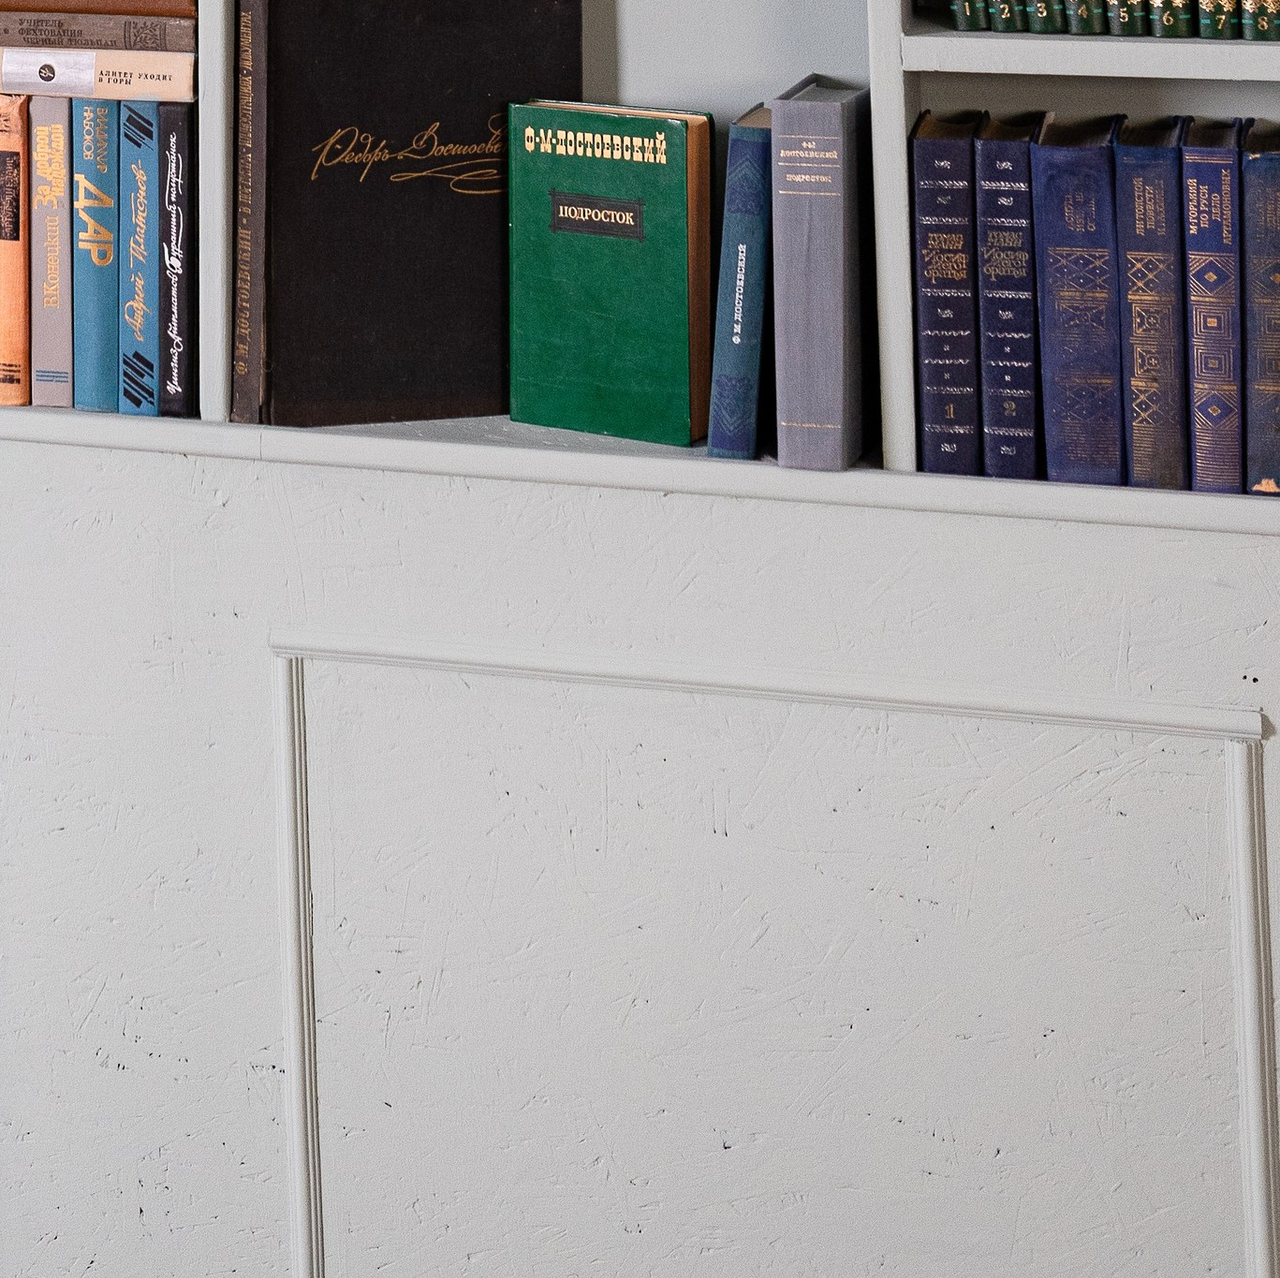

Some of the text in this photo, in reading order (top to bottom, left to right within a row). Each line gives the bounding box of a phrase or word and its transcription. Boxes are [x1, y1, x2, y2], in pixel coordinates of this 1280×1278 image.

[1000, 4, 1011, 19] 2
[1037, 3, 1047, 17] 3
[1119, 7, 1129, 23] 5
[1163, 10, 1174, 26] 6
[98, 70, 173, 81] АЛИТЕТ УХОДИТ
[49, 123, 65, 197] надеждой
[82, 106, 94, 160] НАБОКОВ
[32, 126, 57, 210] За доброй
[73, 173, 114, 267] ДАР
[558, 204, 635, 226] ПОДРОСТОК
[1211, 193, 1220, 221] ДЕЛО
[1221, 169, 1232, 244] АРТАМОНОВЫХ
[124, 159, 153, 340] Андрей Платонов
[162, 132, 183, 395] Чингиз Айтматов Буранный полустанок
[734, 243, 747, 322] ДОСТОЕВСКИЙ
